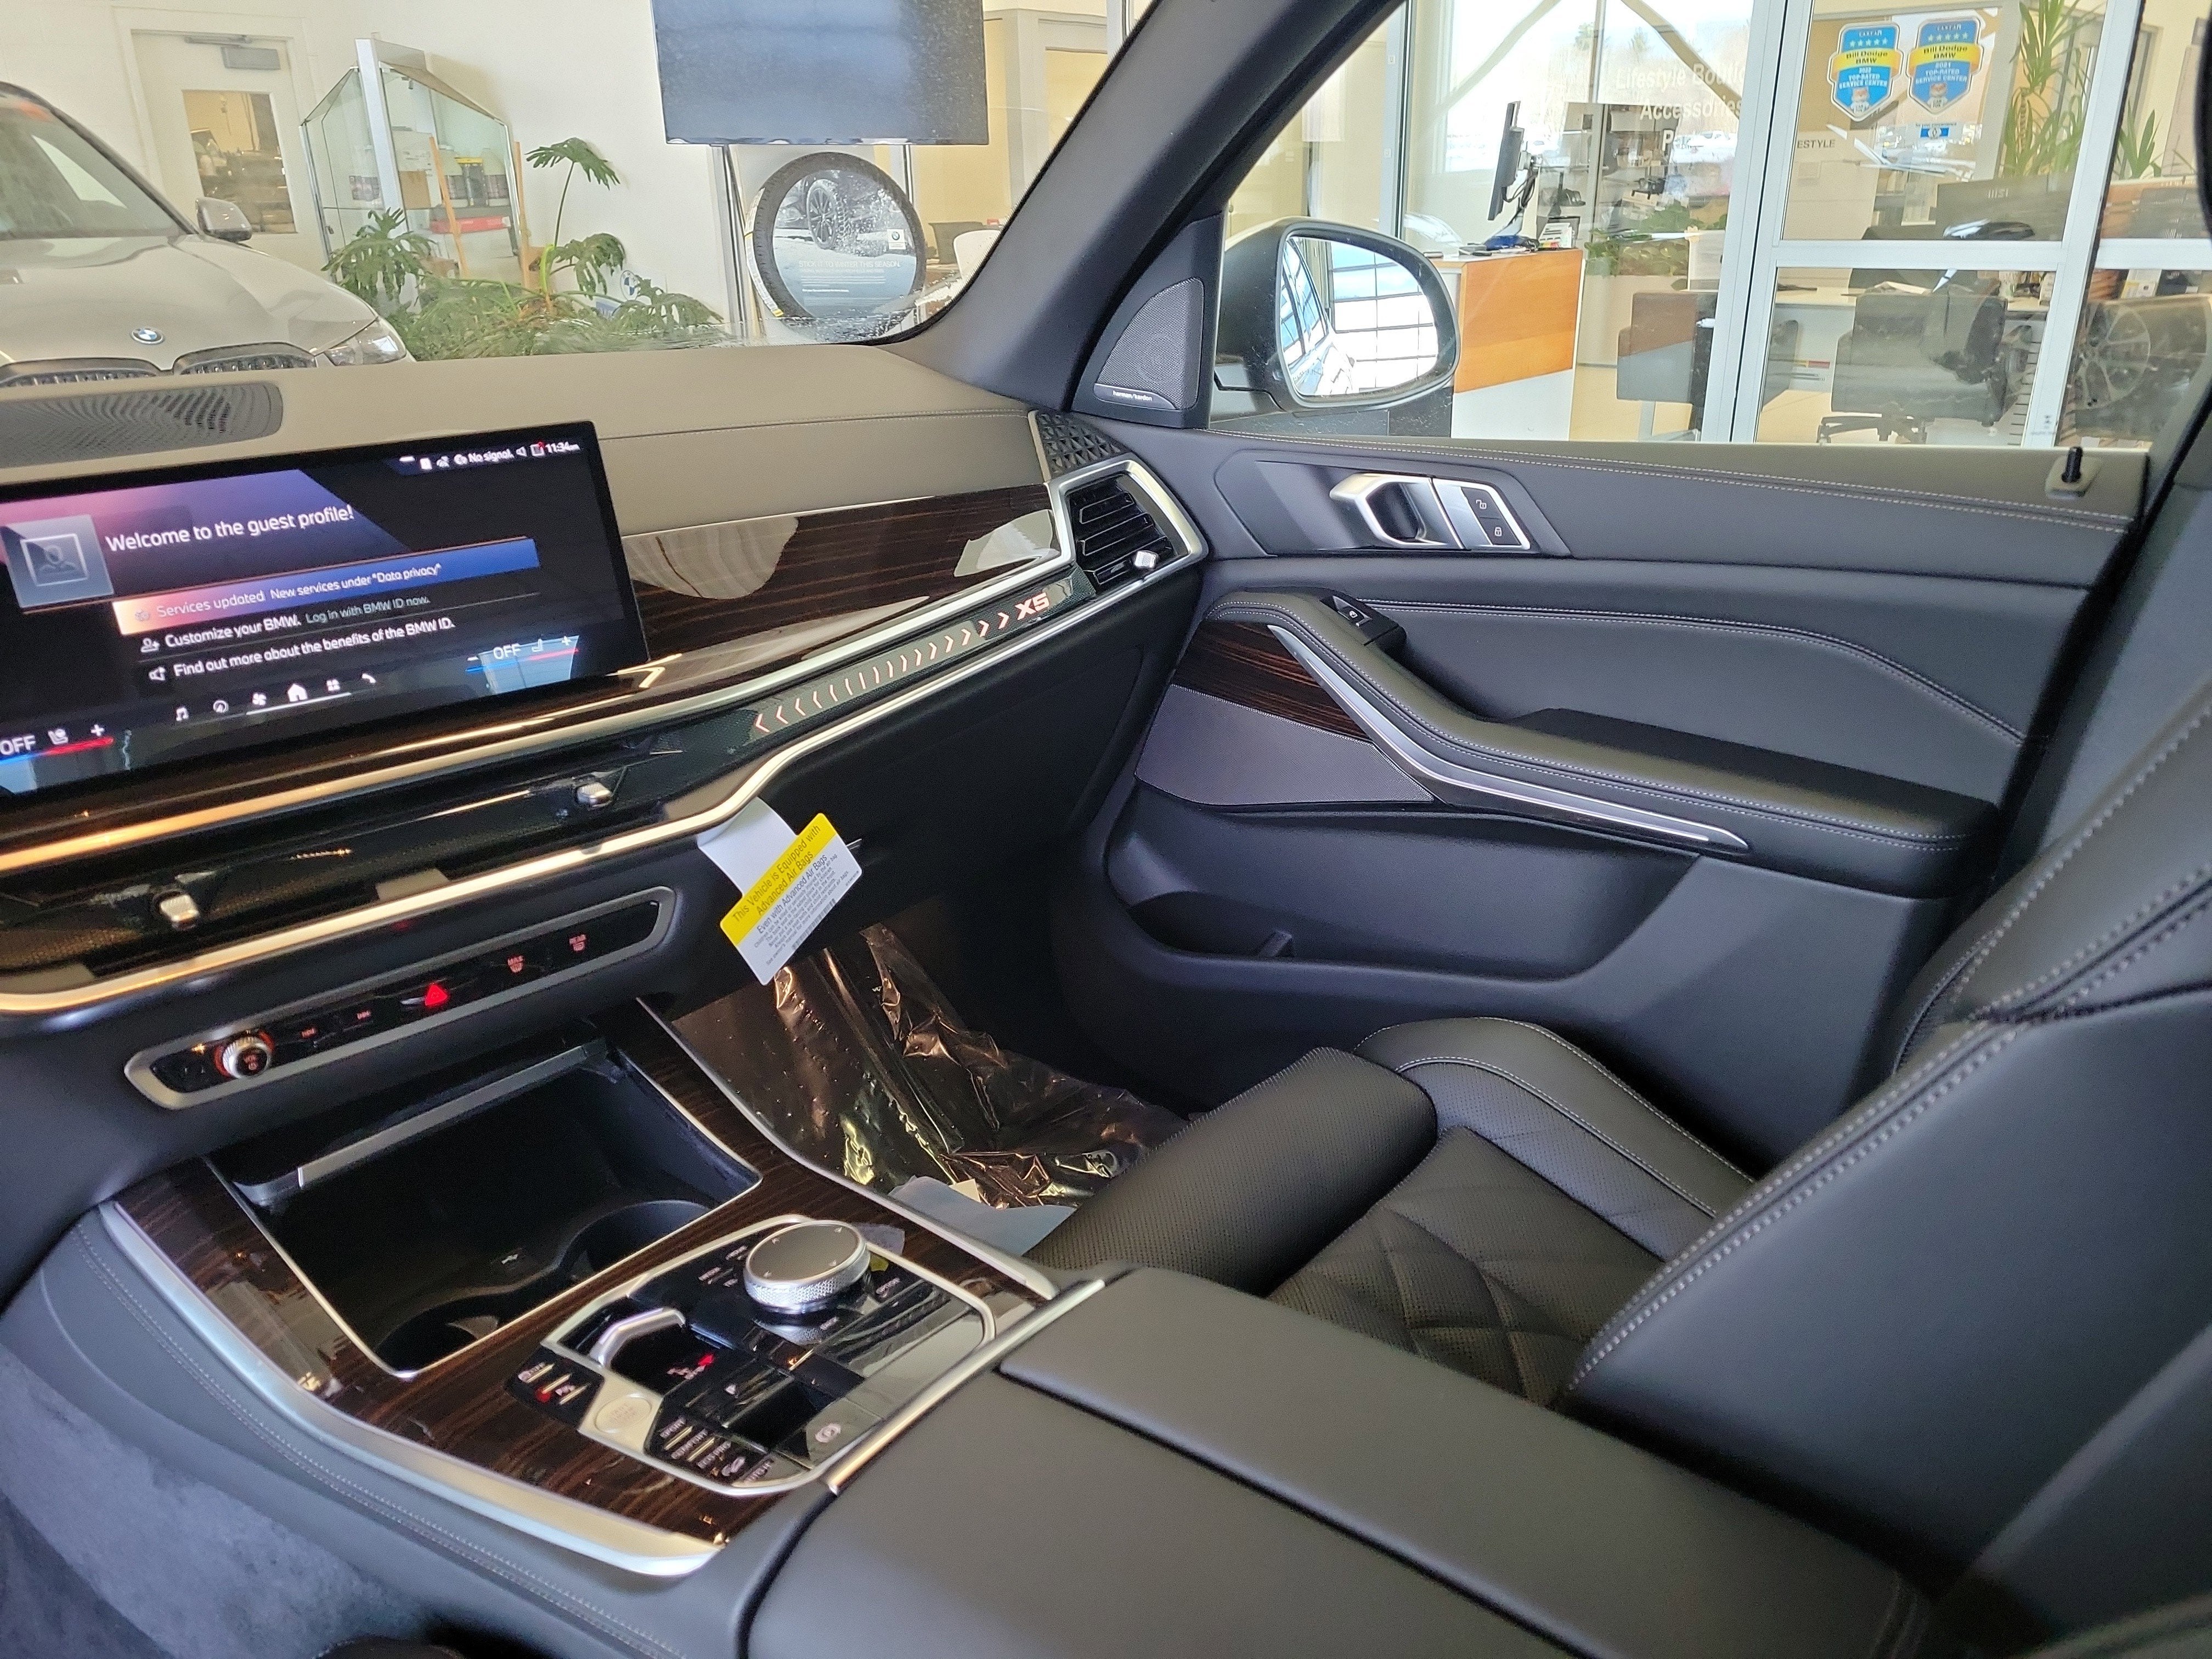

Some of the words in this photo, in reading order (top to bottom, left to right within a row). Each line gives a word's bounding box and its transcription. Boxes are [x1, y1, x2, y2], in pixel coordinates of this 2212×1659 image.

[1846, 51, 1859, 59] Bill
[1923, 46, 1937, 54] Bill
[1939, 44, 1967, 53] Dodge
[1616, 66, 1686, 93] Lifestyle
[1839, 80, 1864, 89] SERVICE
[1848, 73, 1880, 81] TOP-RATED
[1915, 76, 1942, 85] SERVICE
[1925, 68, 1960, 76] TOP-RATED
[468, 452, 484, 463] No
[106, 526, 191, 552] Welcome
[190, 524, 215, 540] to
[211, 518, 247, 538] the
[242, 514, 300, 535] guest
[290, 504, 361, 529] profile!
[269, 585, 295, 600] New
[295, 579, 341, 596] services
[340, 573, 372, 589] under
[155, 598, 212, 618] Services
[212, 590, 266, 610] updated
[304, 610, 328, 625] Log
[327, 609, 338, 620] in
[338, 604, 363, 618] with
[362, 600, 391, 614] BMW
[391, 597, 404, 609] ID
[1015, 592, 1049, 620] X5
[163, 624, 234, 648] Customize
[233, 621, 264, 639] your
[262, 613, 302, 631] BMW.
[172, 659, 204, 677] Find
[204, 657, 228, 672] out
[228, 651, 263, 668] more
[262, 642, 301, 662] about
[300, 639, 323, 654] the
[321, 630, 370, 651] benefits
[370, 628, 385, 641] of
[384, 625, 405, 639] the
[404, 619, 438, 636] BMW
[437, 616, 455, 630] ID.
[493, 644, 521, 659] OFF
[1, 734, 36, 755] OFF
[732, 902, 749, 923] This
[746, 876, 772, 907] Vehicle
[770, 869, 780, 882] is
[776, 838, 808, 875] Equipped
[804, 822, 821, 843] with
[755, 877, 788, 916] Advanced
[785, 866, 798, 882] Air
[795, 848, 815, 872] Bags
[756, 915, 772, 934] Even
[769, 902, 783, 919] with
[781, 876, 807, 906] Advanced
[804, 866, 815, 879] Air
[812, 852, 828, 872] Bags
